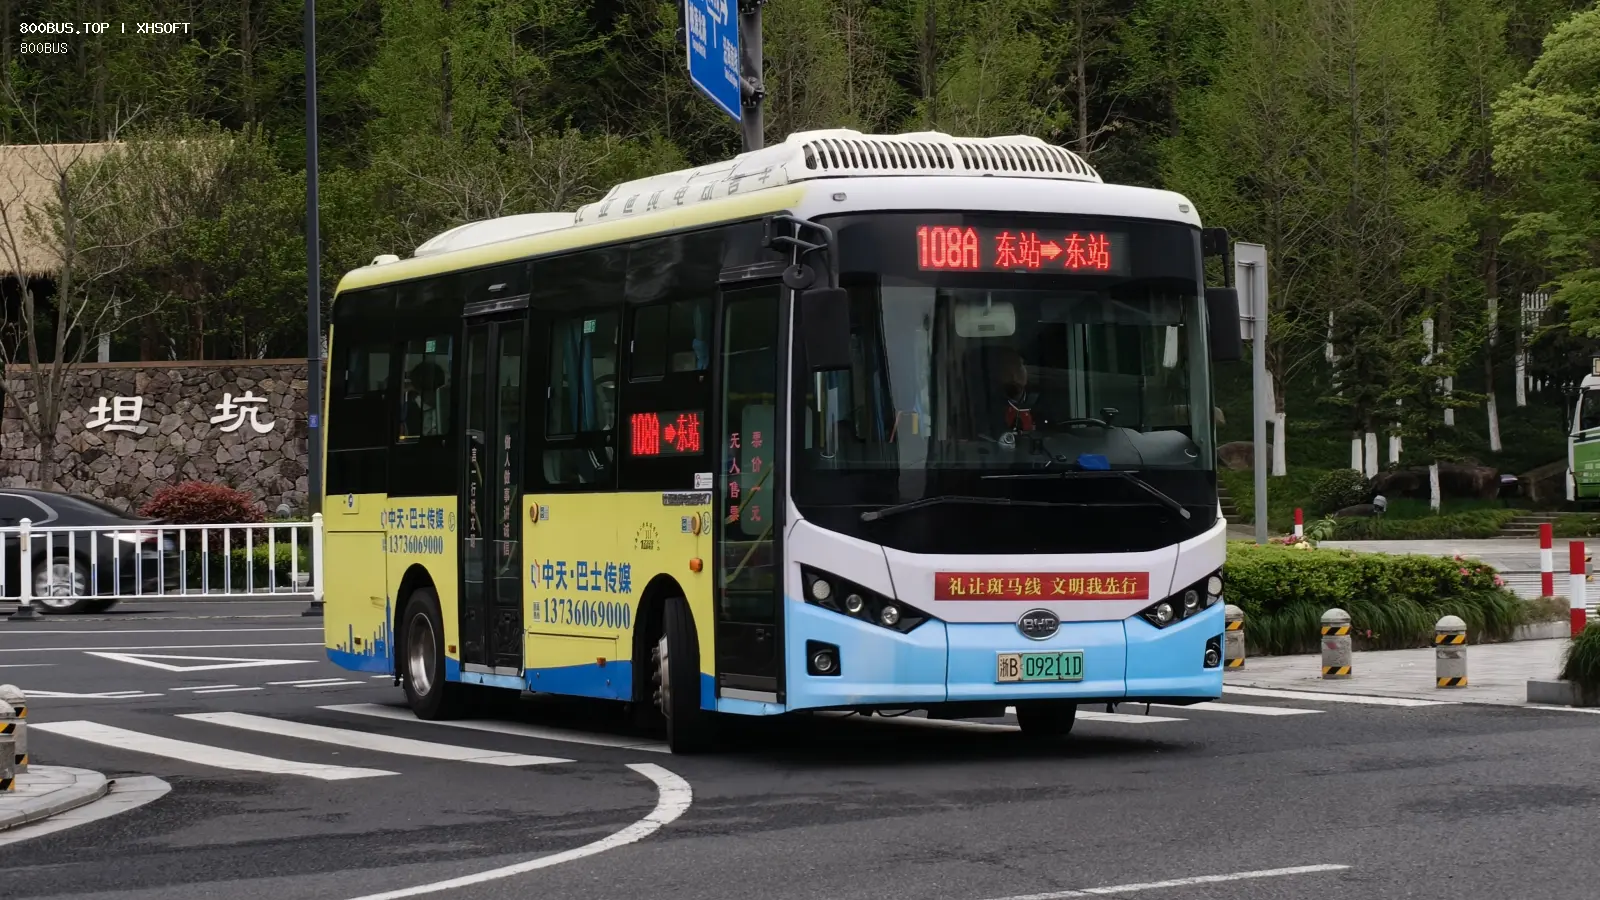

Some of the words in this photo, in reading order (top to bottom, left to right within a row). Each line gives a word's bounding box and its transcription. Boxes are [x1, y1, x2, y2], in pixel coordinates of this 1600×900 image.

[917, 226, 978, 268] 108A
[995, 231, 1041, 268] 东站
[1064, 233, 1110, 269] 东站
[85, 390, 276, 434] 坦坑
[631, 413, 660, 455] 108A
[676, 413, 700, 452] 东站
[729, 432, 741, 521] 无人售票
[751, 431, 763, 521] 票价一元
[389, 535, 444, 555] 13736069000
[949, 577, 1042, 596] 礼让斑马线
[1050, 577, 1138, 595] 文明我先行
[544, 598, 631, 629] 13736069000
[1023, 618, 1056, 631] BYD
